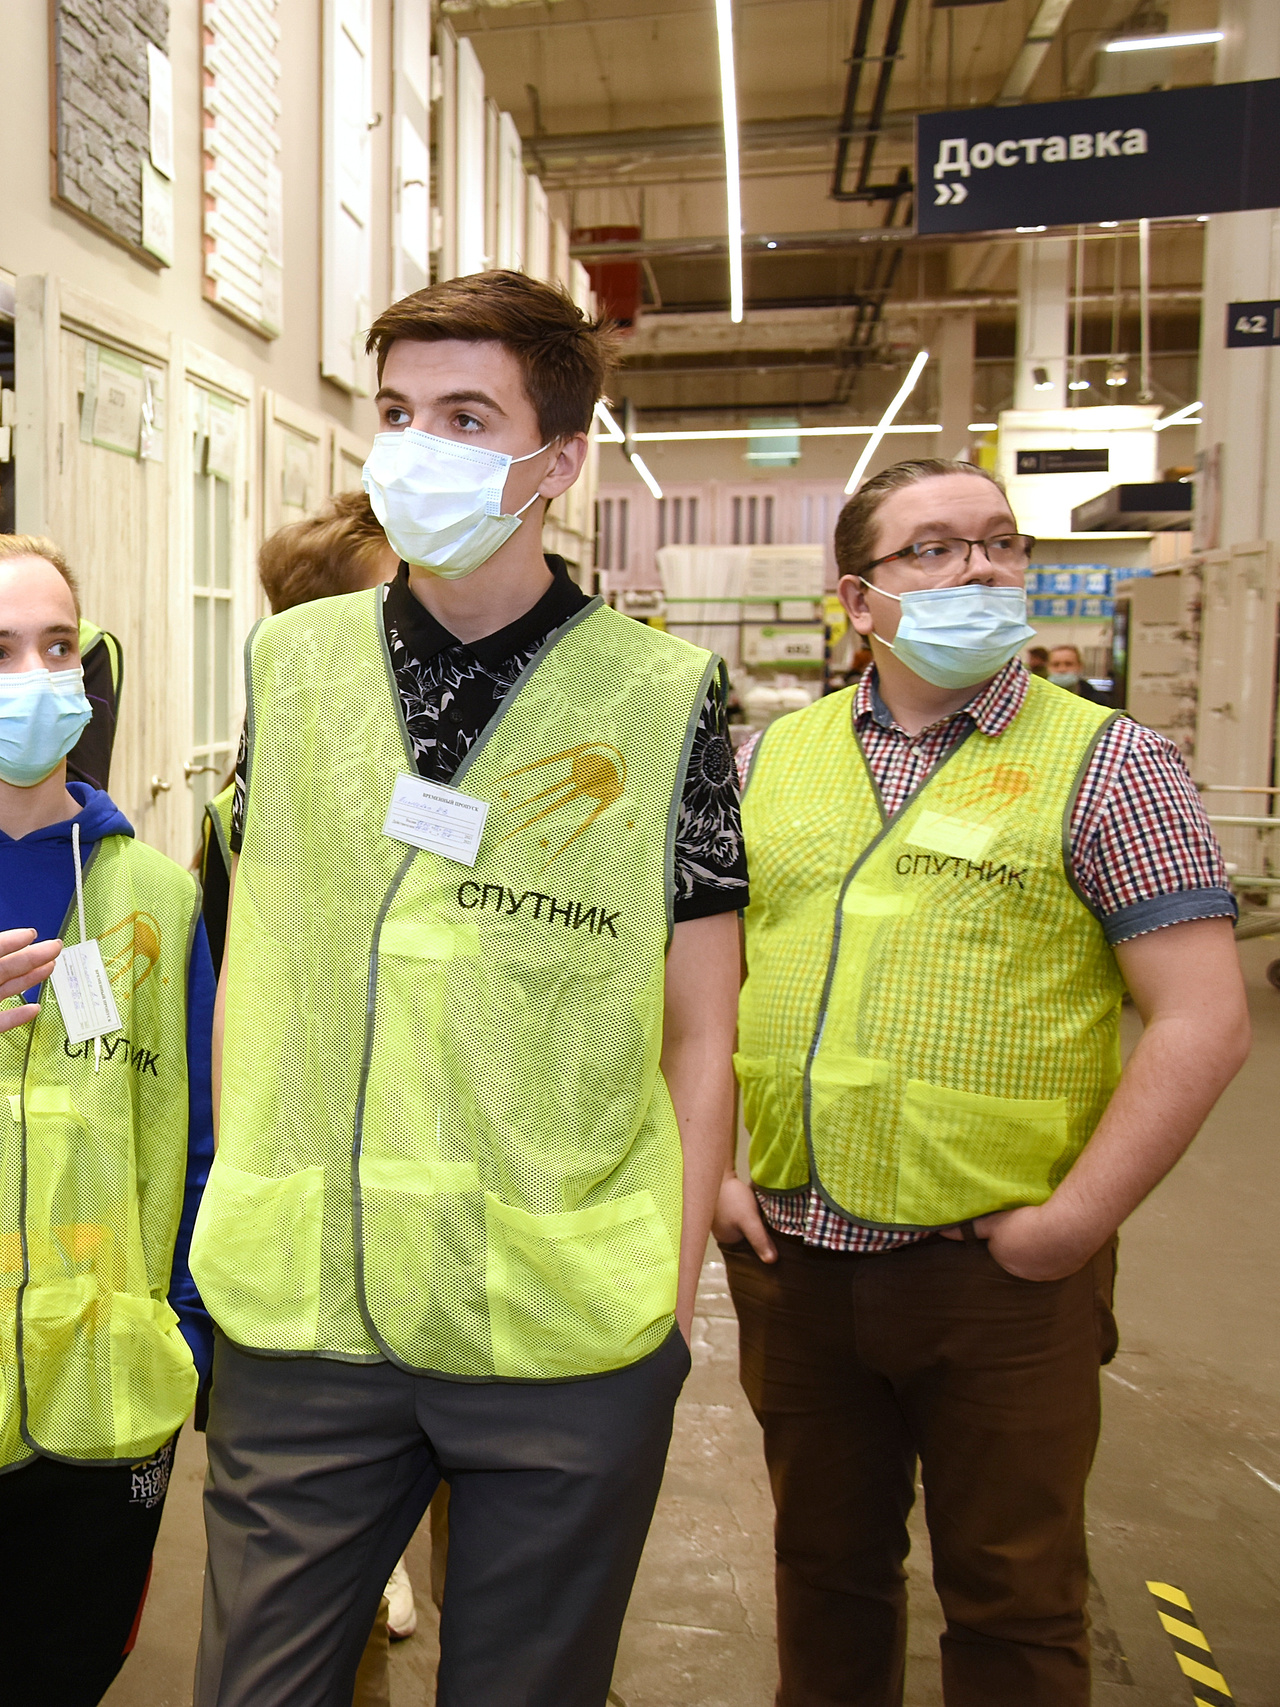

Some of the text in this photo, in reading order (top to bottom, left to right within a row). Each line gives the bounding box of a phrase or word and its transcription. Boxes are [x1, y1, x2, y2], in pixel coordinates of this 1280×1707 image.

[933, 128, 1148, 180] Доставка
[1234, 315, 1268, 334] 42
[896, 854, 1029, 890] СПУТНИК
[457, 880, 622, 939] СПУТНИК
